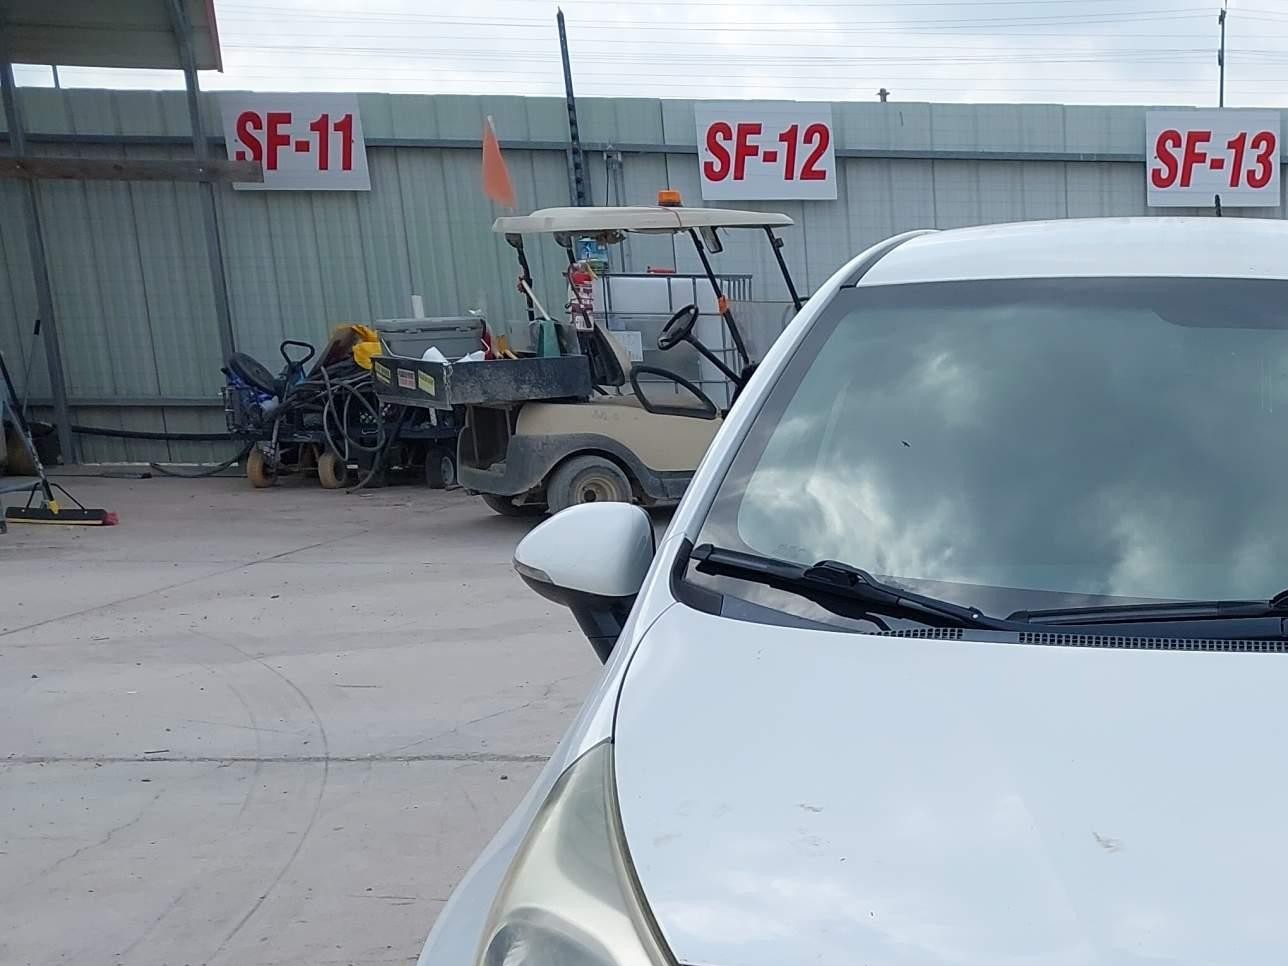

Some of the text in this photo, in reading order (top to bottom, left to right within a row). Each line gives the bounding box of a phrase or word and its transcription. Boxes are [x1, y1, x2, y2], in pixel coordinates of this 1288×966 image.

[235, 111, 353, 171] SF-11
[703, 122, 829, 182] SF-12
[1151, 130, 1277, 189] SF-13
